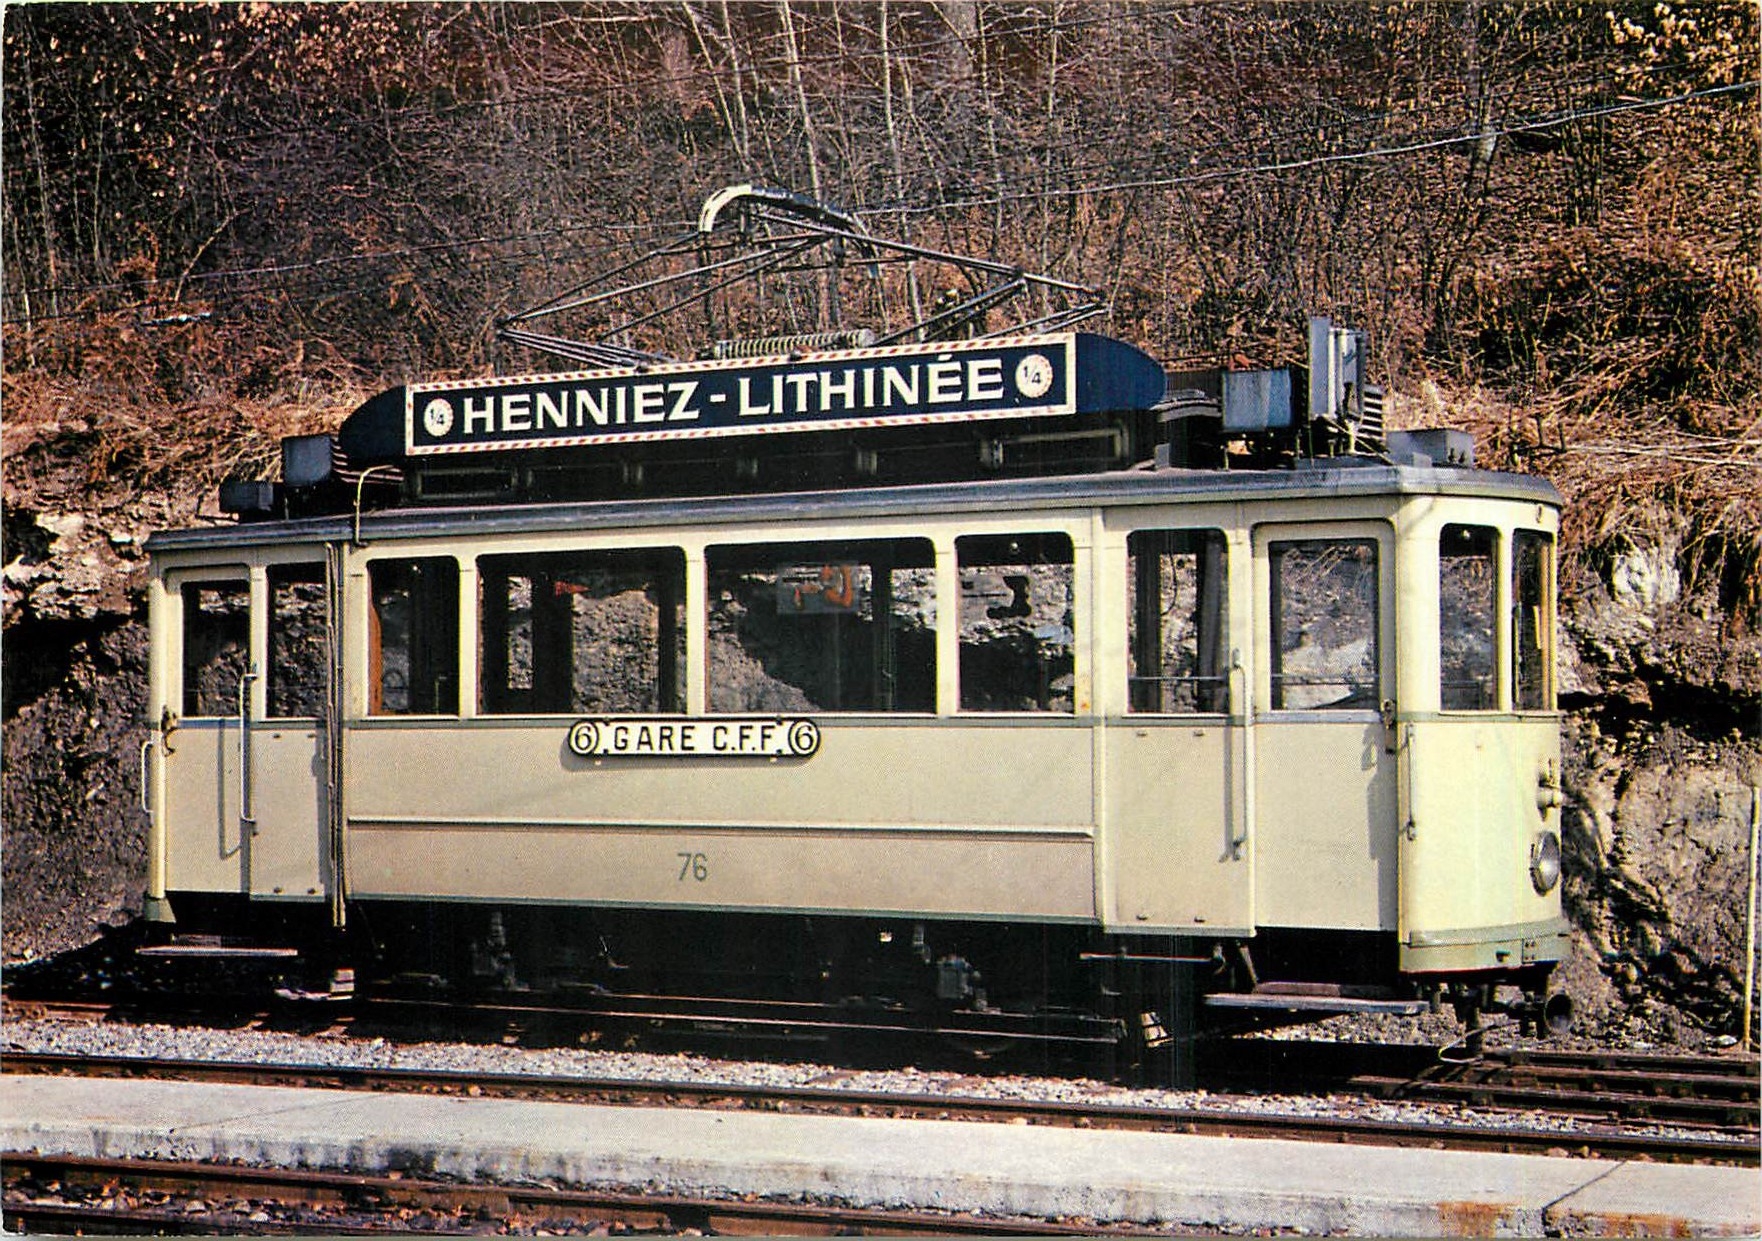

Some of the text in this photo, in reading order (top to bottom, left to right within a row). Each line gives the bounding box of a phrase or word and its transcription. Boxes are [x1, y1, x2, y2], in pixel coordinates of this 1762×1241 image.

[463, 381, 700, 434] HENNIEZ
[710, 394, 726, 403] -
[738, 354, 1004, 416] LITHINÉE
[574, 725, 593, 750] 6
[614, 726, 695, 751] GARE
[795, 725, 814, 750] 6
[677, 852, 708, 881] 76
